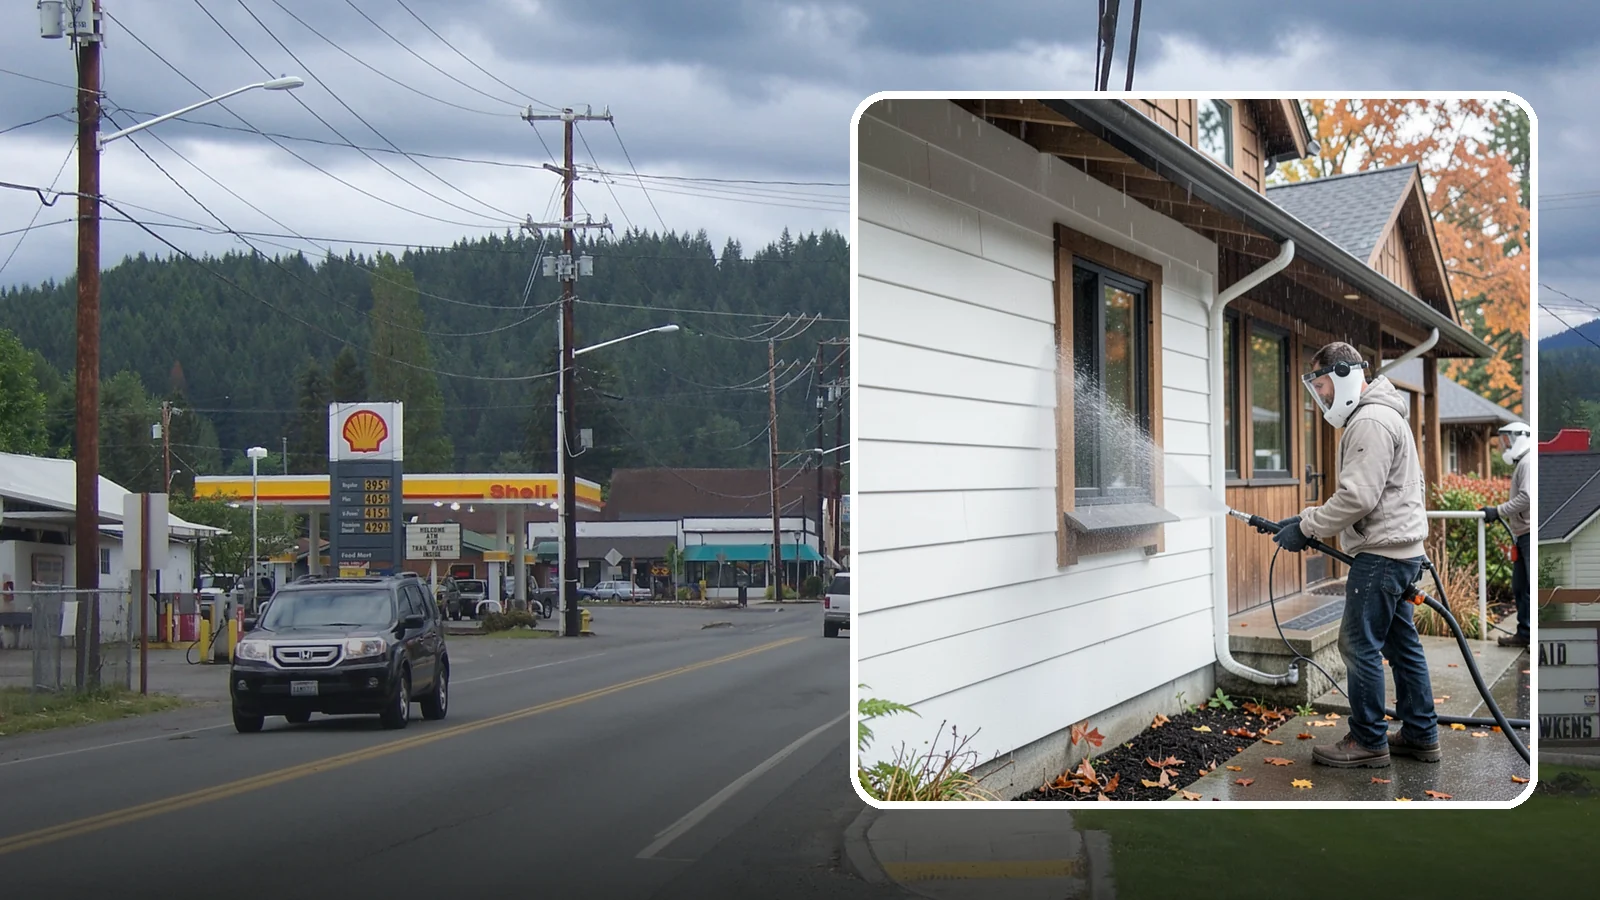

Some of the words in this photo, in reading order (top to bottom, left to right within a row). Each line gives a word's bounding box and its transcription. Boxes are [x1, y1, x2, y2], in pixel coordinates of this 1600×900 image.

[366, 480, 384, 490] 395
[490, 484, 547, 499] Shell
[366, 494, 384, 504] 405
[366, 508, 384, 518] 415
[366, 522, 384, 533] 429
